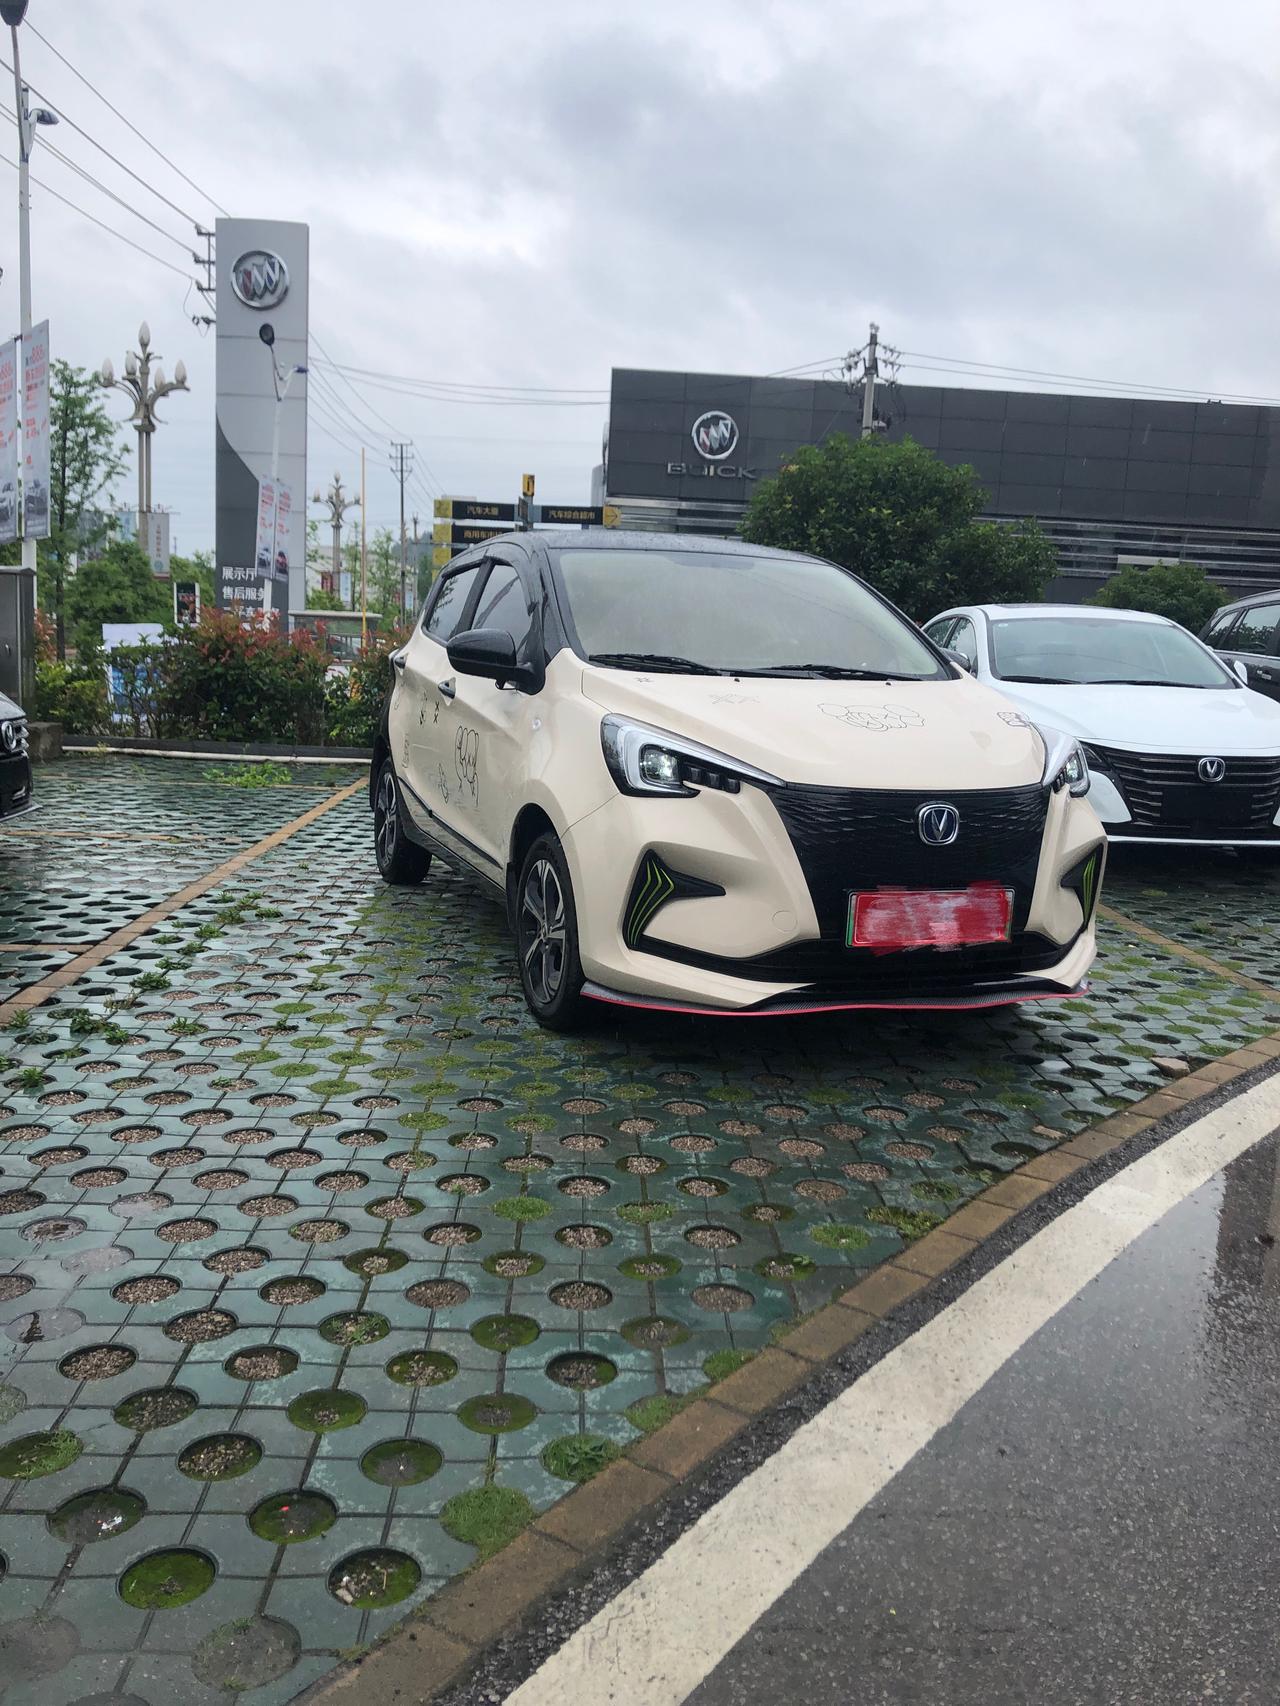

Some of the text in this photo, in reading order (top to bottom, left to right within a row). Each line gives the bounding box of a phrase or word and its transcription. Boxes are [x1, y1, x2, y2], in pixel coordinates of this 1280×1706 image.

[667, 462, 758, 479] BUICK
[222, 566, 256, 581] 展示厅
